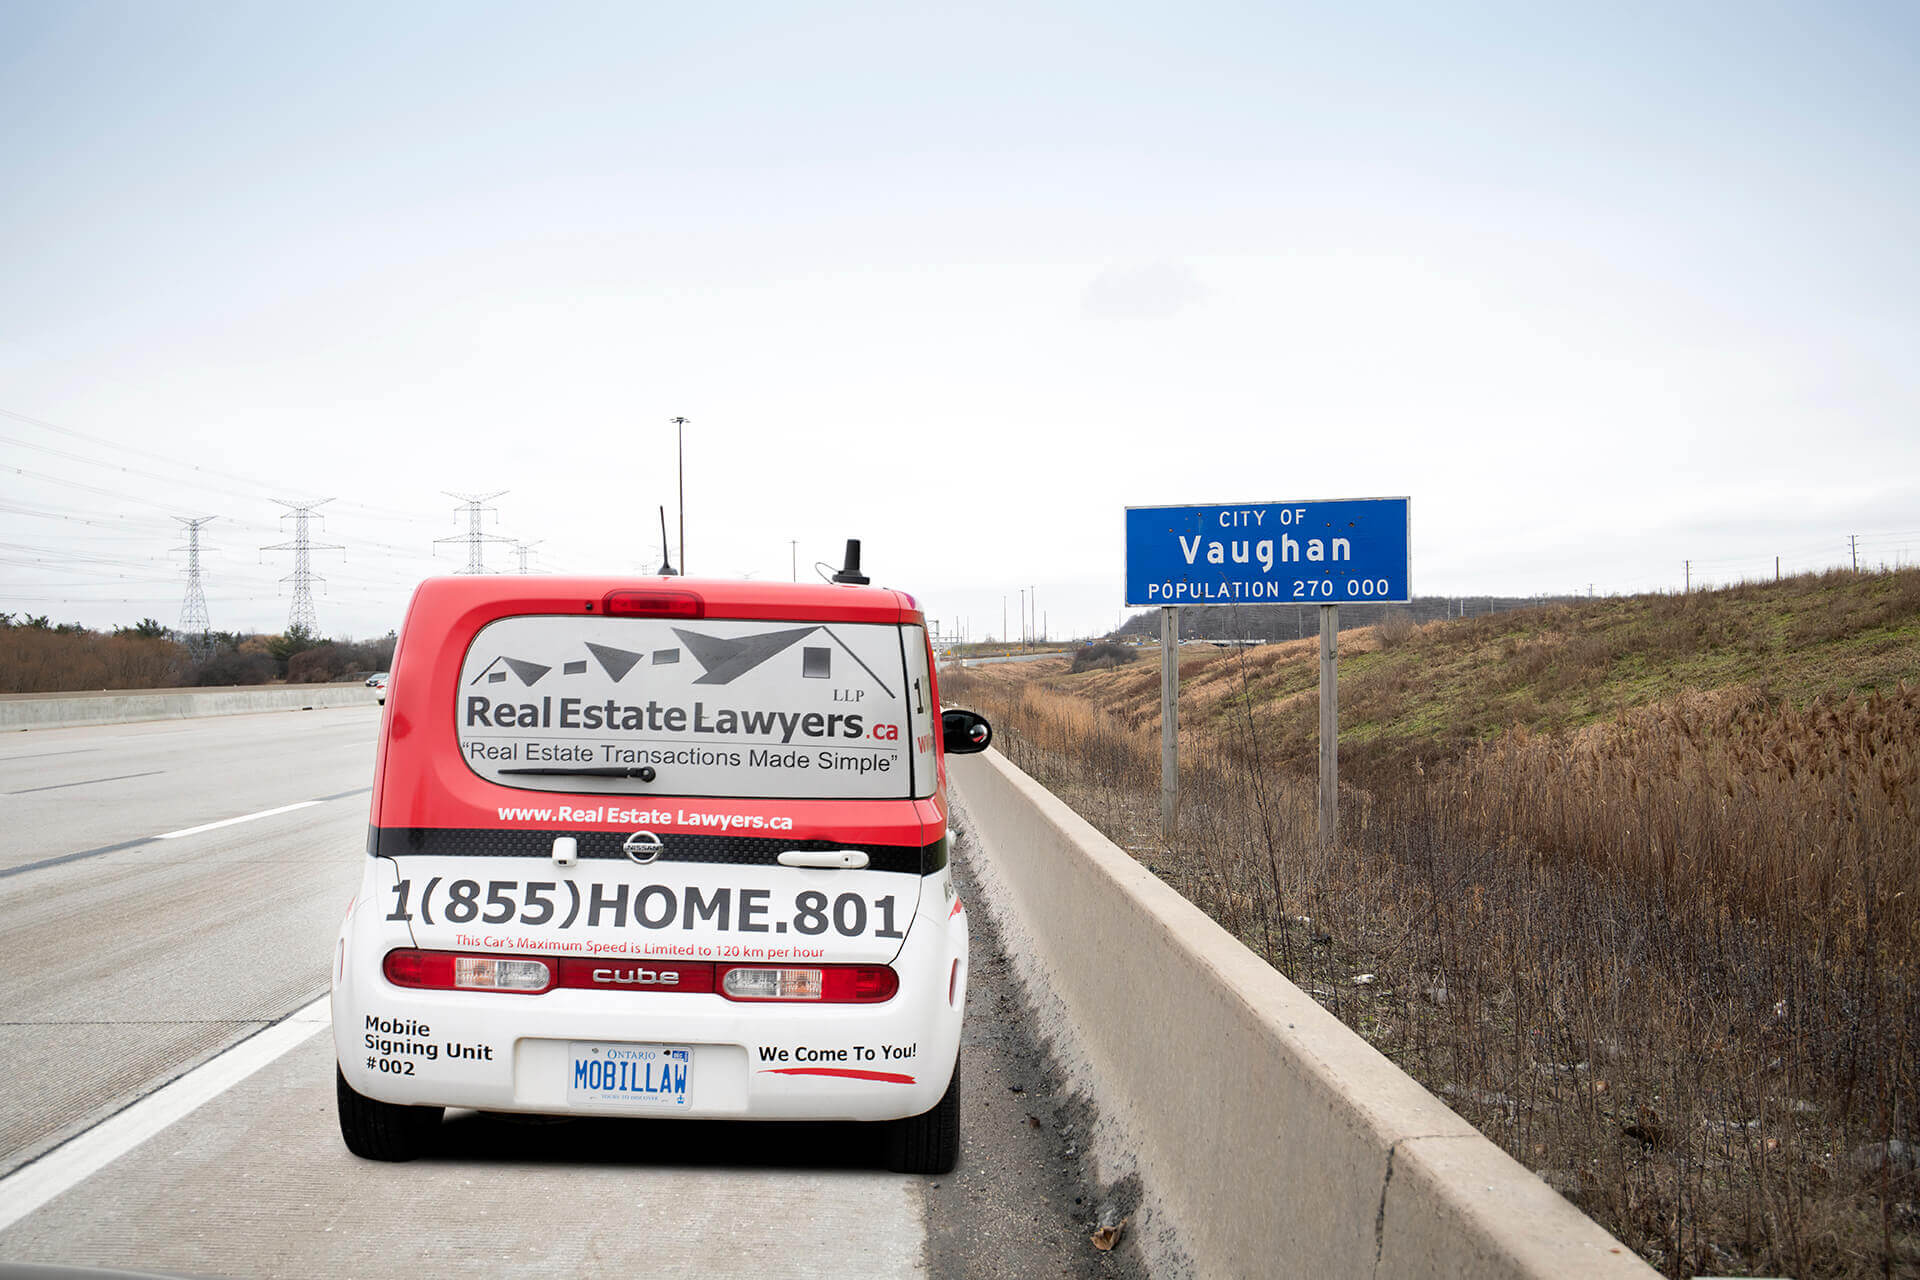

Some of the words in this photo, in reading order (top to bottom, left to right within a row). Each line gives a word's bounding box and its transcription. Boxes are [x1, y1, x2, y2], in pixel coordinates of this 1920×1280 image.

[1219, 510, 1266, 527] CITY
[1280, 508, 1306, 525] OF
[1179, 532, 1351, 573] Vaughan
[1148, 581, 1279, 599] POPULATION
[1293, 580, 1333, 597] 270
[1347, 579, 1389, 596] 000
[833, 688, 865, 703] LLP
[526, 743, 593, 762] Estate
[601, 745, 740, 767] Transactions
[749, 749, 810, 769] Made
[498, 806, 603, 823] www.Real
[607, 807, 672, 825] Estate
[677, 810, 793, 831] Lawyers.ca
[456, 934, 480, 947] This
[517, 937, 582, 951] Maximum
[586, 940, 627, 954] Speed
[631, 943, 640, 953] is
[645, 943, 694, 956] Limited
[698, 945, 712, 956] to
[716, 945, 740, 957] 120
[743, 946, 764, 957] km
[767, 948, 790, 960] per
[793, 946, 825, 958] hour
[593, 968, 679, 985] cube
[365, 1034, 438, 1060] Signing
[446, 1043, 493, 1060] Unit
[758, 1047, 789, 1061] We
[795, 1047, 848, 1062] Come
[853, 1046, 876, 1061] To
[881, 1043, 917, 1059] You!
[366, 1056, 415, 1076] #002
[574, 1059, 687, 1094] MOBILLAW
